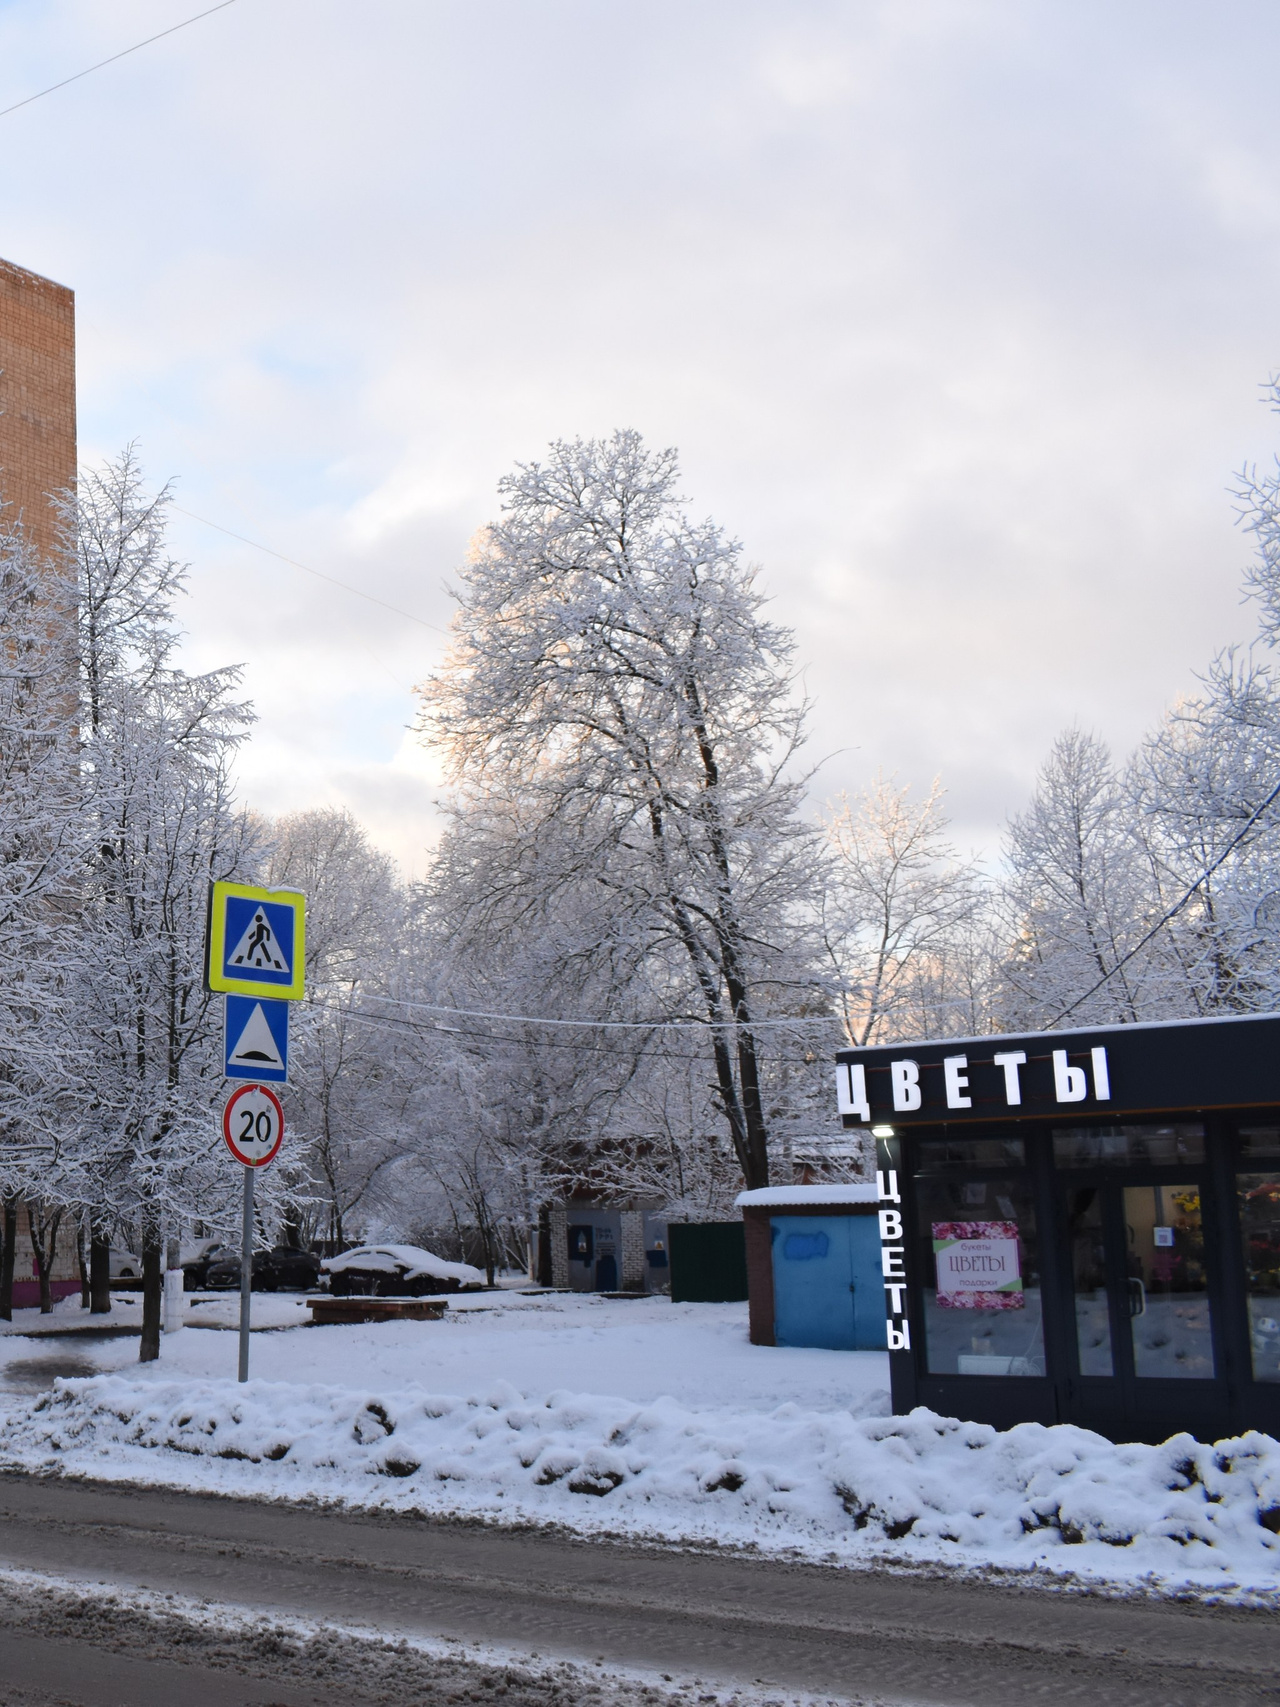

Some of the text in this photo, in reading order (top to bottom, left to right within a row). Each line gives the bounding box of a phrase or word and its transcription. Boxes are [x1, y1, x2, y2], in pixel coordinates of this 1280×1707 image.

[836, 1047, 1111, 1121] ЦВЕТЫ
[239, 1110, 271, 1142] 20
[876, 1170, 911, 1350] ЦВЕТЫ
[960, 1243, 992, 1252] букеты
[949, 1255, 1006, 1273] ЦВЕТЫ
[959, 1279, 998, 1287] подарки
